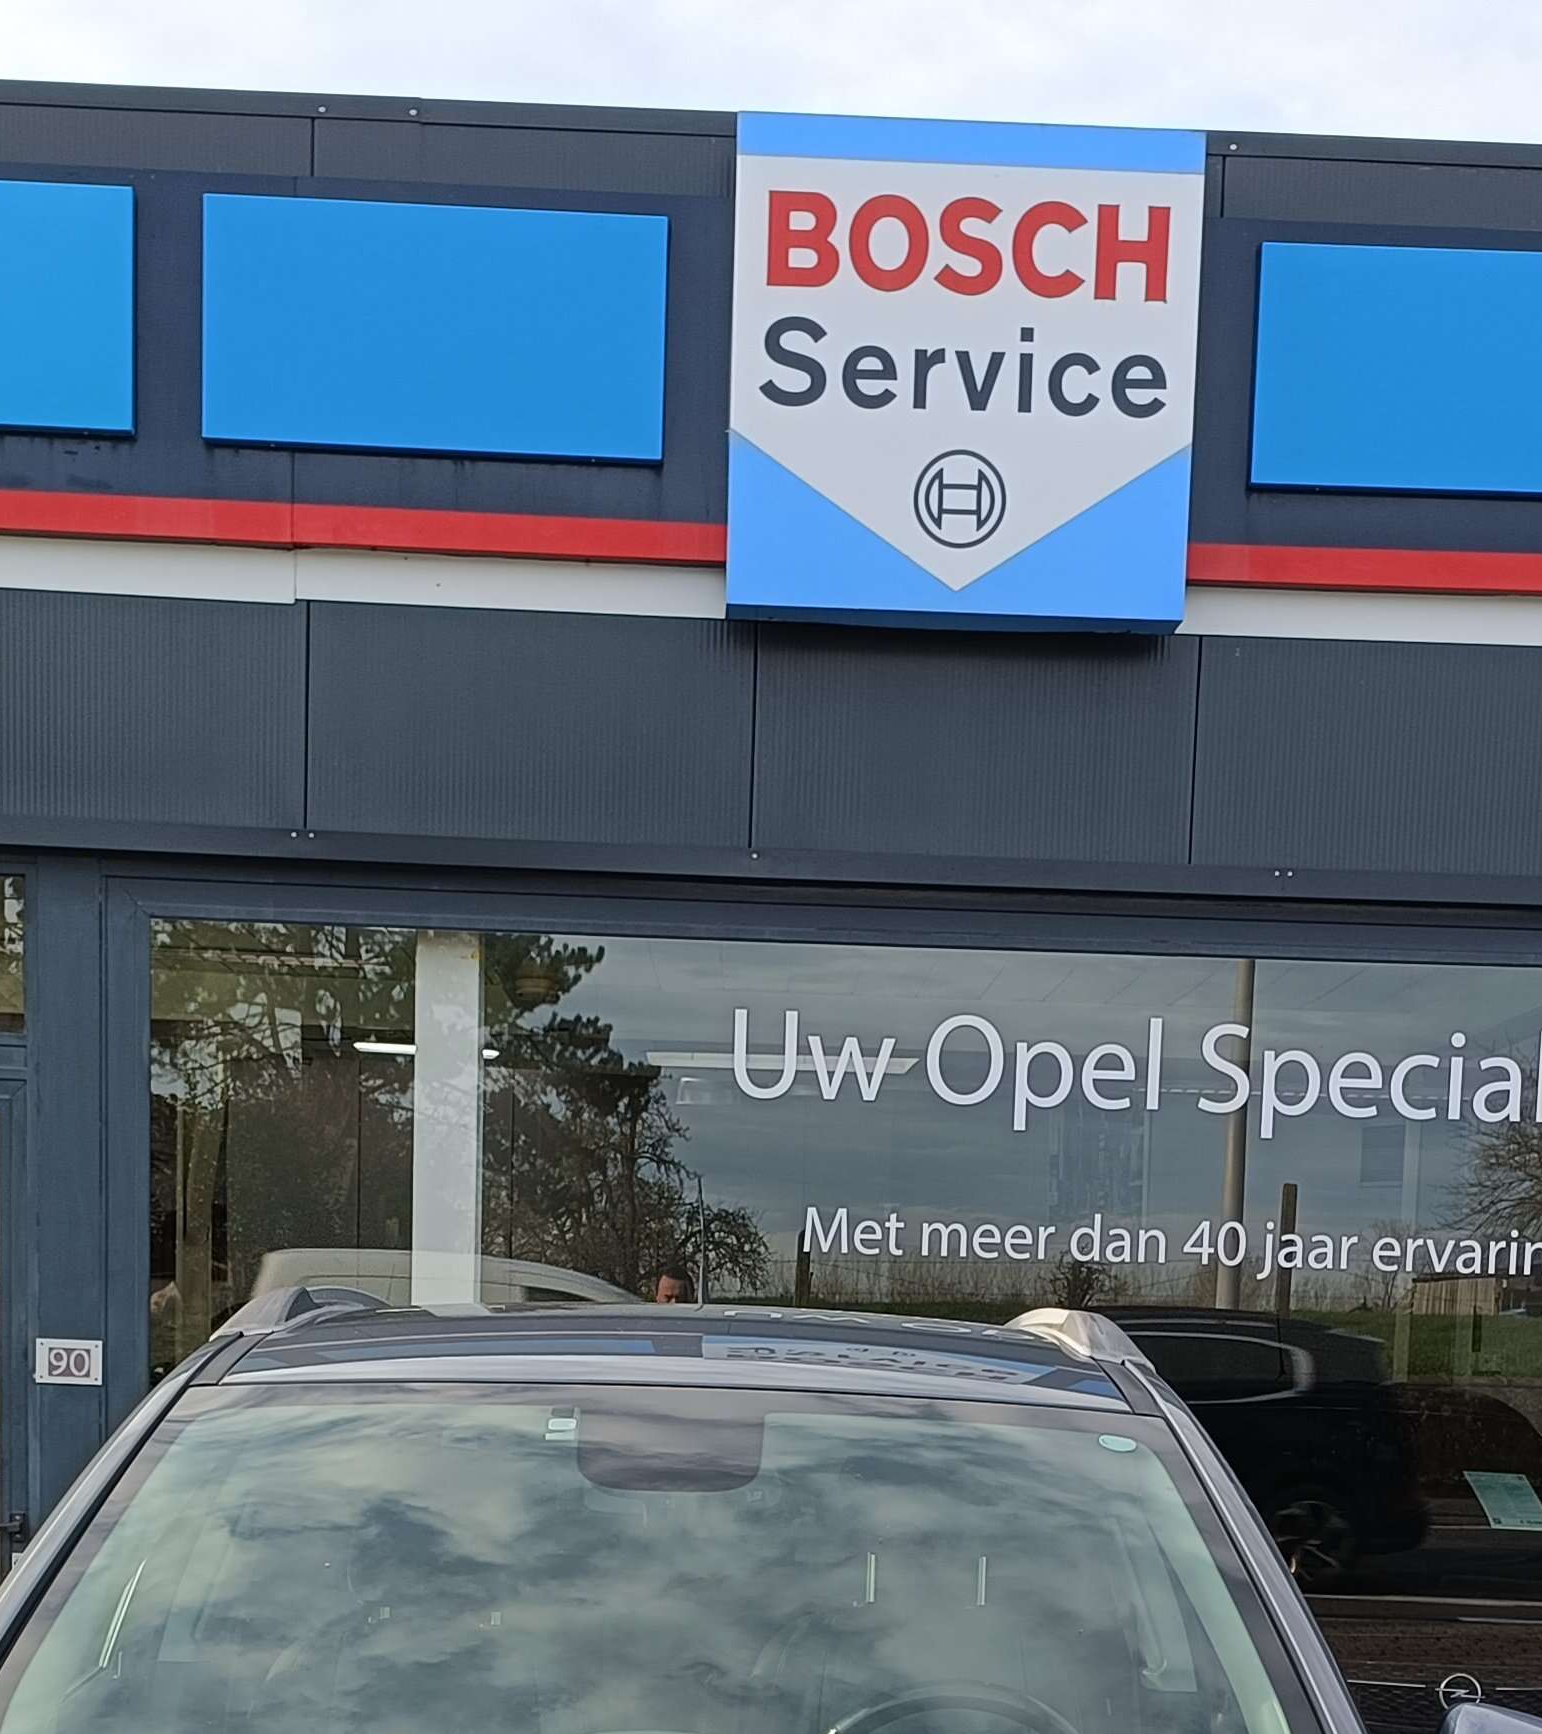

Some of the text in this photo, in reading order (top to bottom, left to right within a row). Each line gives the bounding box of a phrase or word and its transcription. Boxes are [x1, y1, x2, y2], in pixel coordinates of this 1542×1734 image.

[766, 190, 1171, 303] BOSCH
[759, 316, 1168, 418] Service
[732, 1008, 896, 1102] Uw
[925, 1015, 1163, 1132] Opel
[801, 1206, 905, 1258] Met
[921, 1222, 1056, 1262] meer
[1069, 1213, 1165, 1266] dan
[1184, 1219, 1247, 1267] 40
[1258, 1220, 1358, 1281] jaar
[49, 1348, 90, 1377] 90
